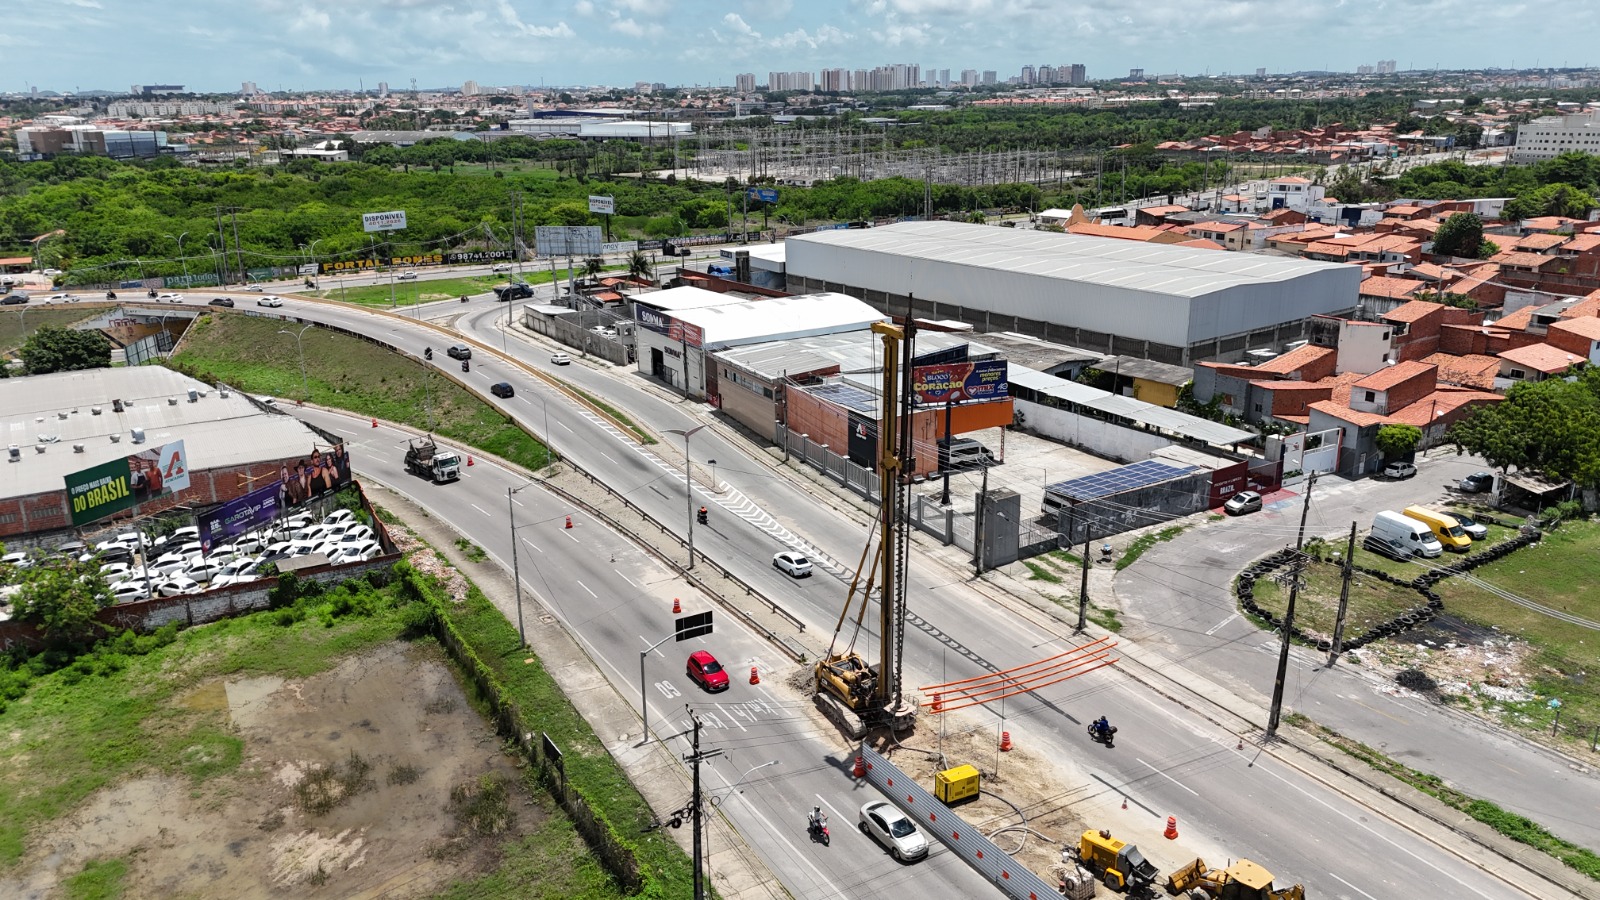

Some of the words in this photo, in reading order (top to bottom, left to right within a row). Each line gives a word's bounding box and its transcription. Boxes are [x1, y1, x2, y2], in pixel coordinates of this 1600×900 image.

[364, 213, 404, 222] DISPONÍVEL
[323, 259, 384, 270] FORTAL
[75, 481, 90, 494] PREÇO
[89, 478, 100, 489] MAIS
[99, 475, 112, 485] BAIXO
[73, 495, 88, 513] DO
[86, 475, 130, 508] BRASIL
